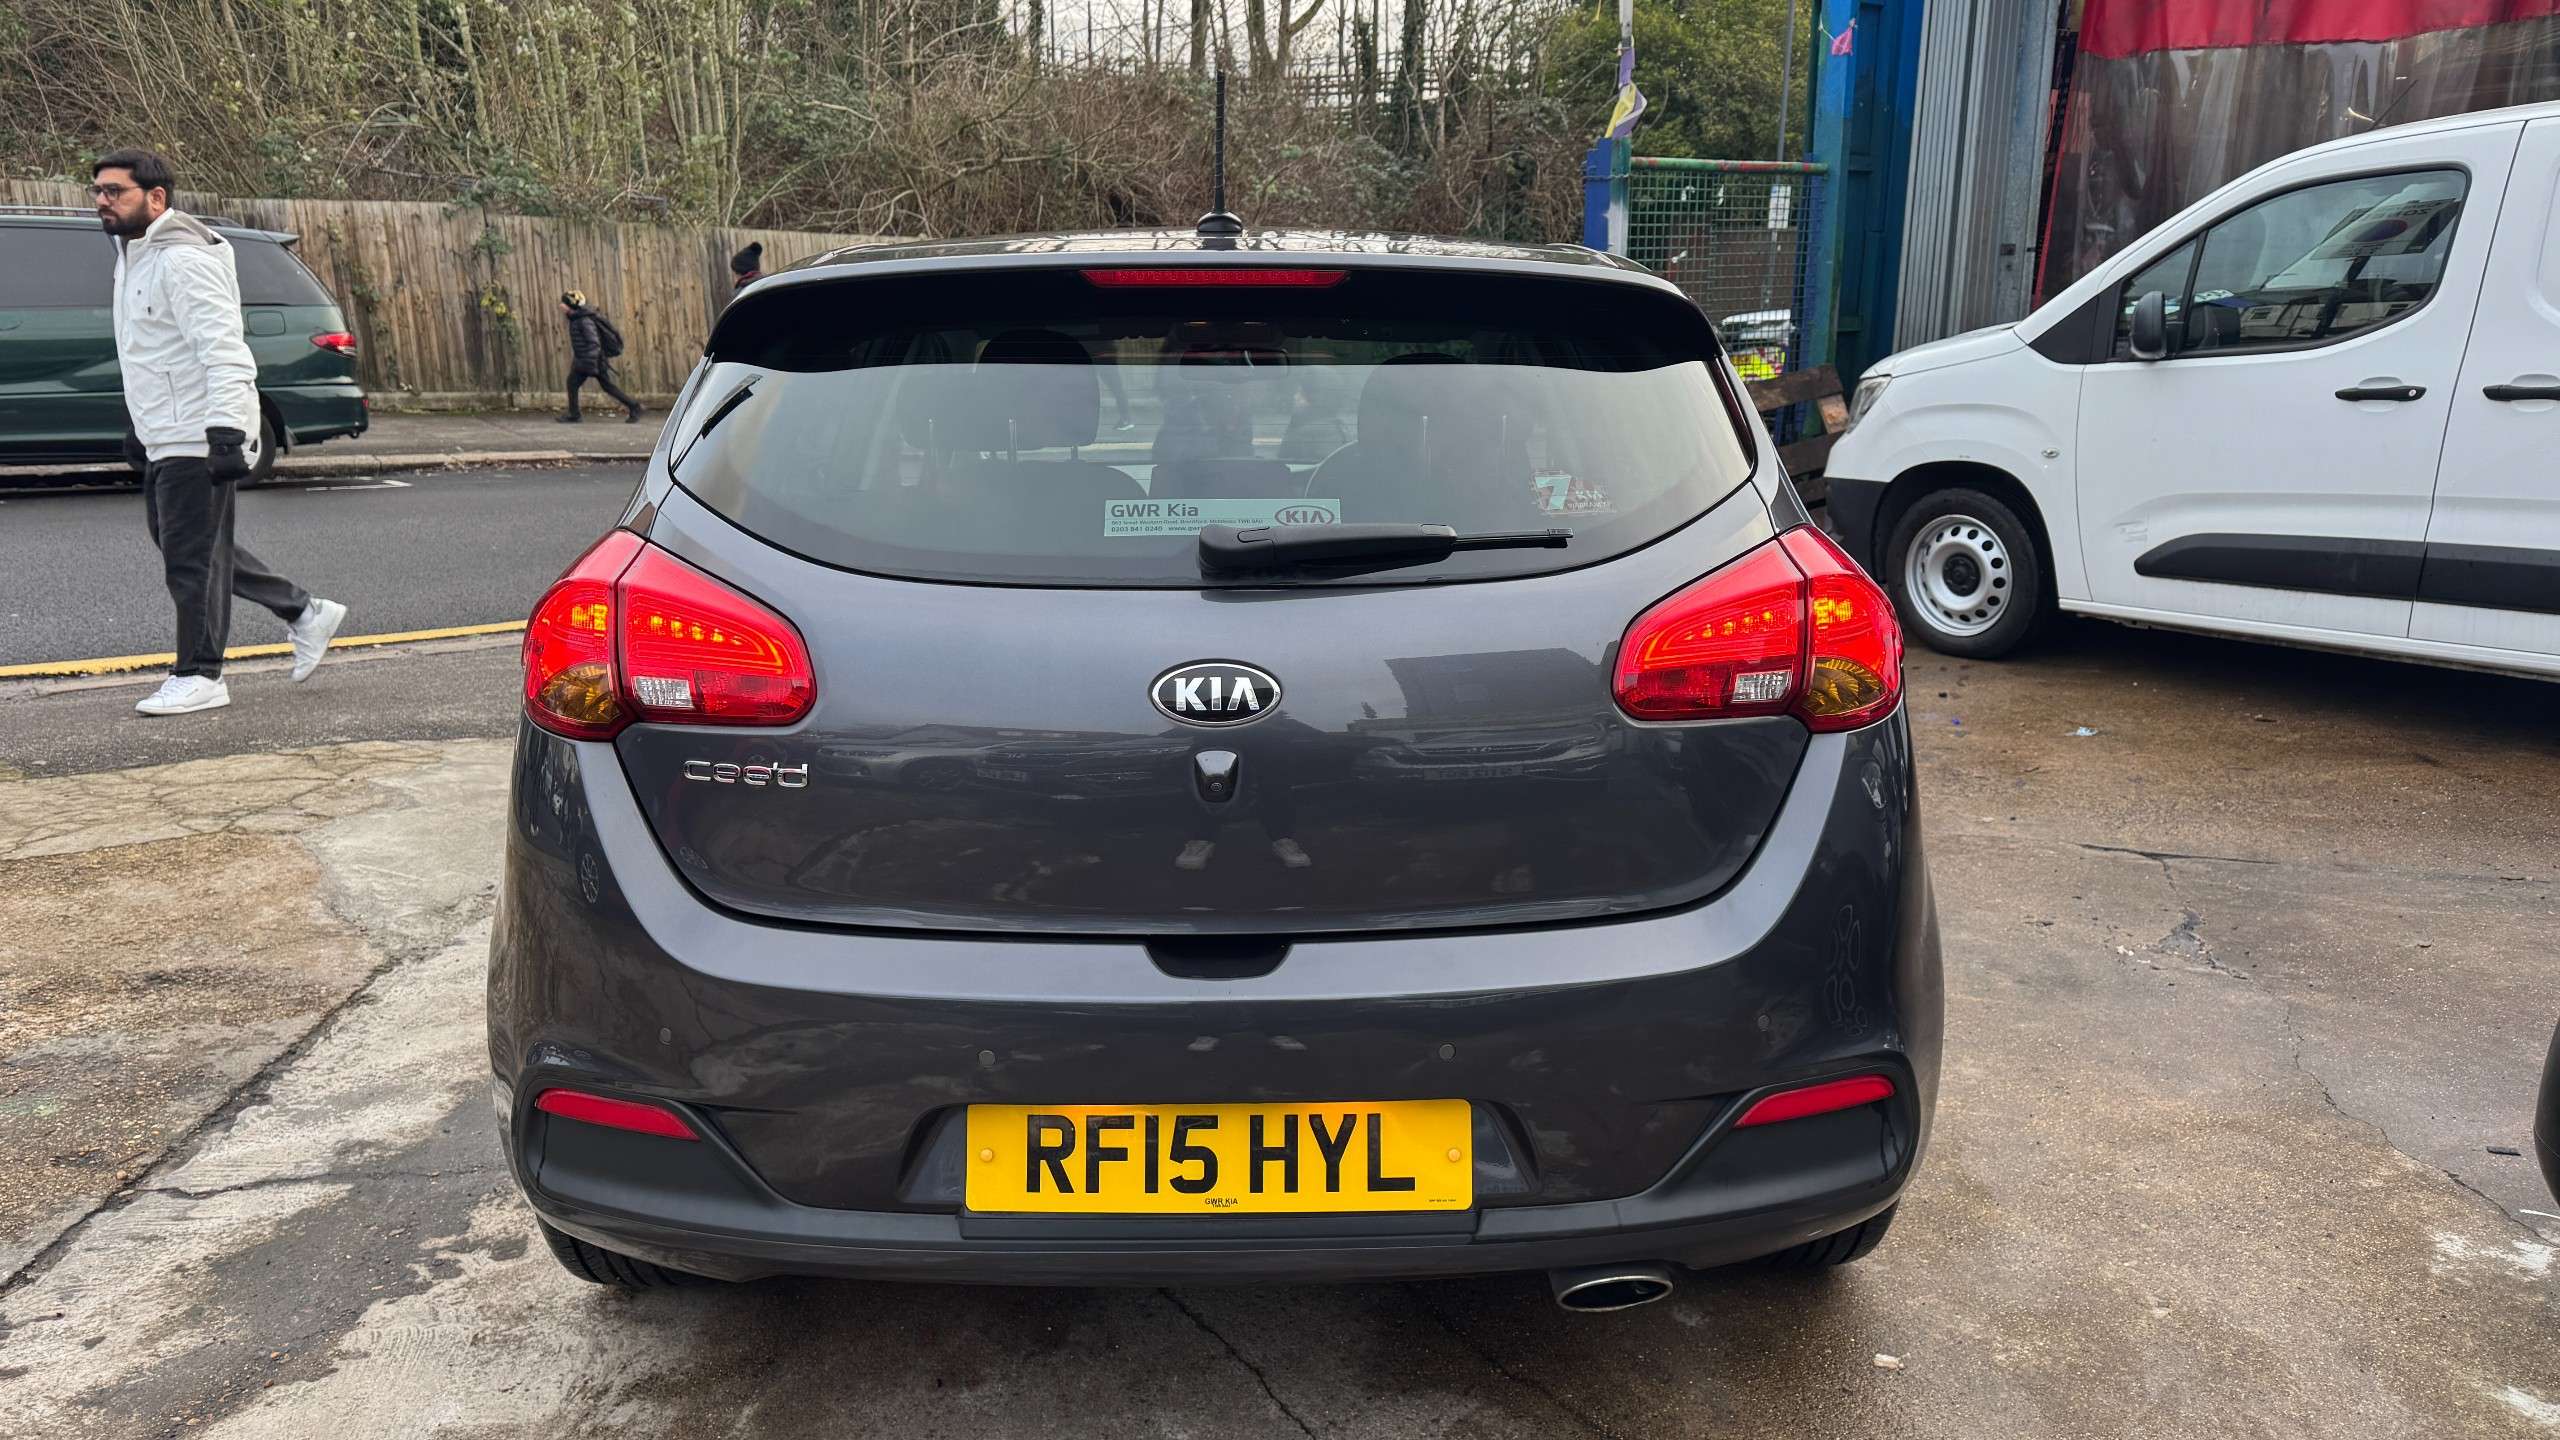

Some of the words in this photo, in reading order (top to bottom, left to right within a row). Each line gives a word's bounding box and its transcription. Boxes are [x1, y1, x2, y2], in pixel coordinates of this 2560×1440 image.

[1110, 503, 1160, 518] GWR
[1167, 503, 1199, 517] Kia
[1285, 510, 1325, 524] KIA
[1173, 676, 1260, 711] KIA
[683, 760, 809, 788] cee'd
[1026, 1114, 1219, 1194] RF15
[1249, 1112, 1416, 1194] HYL
